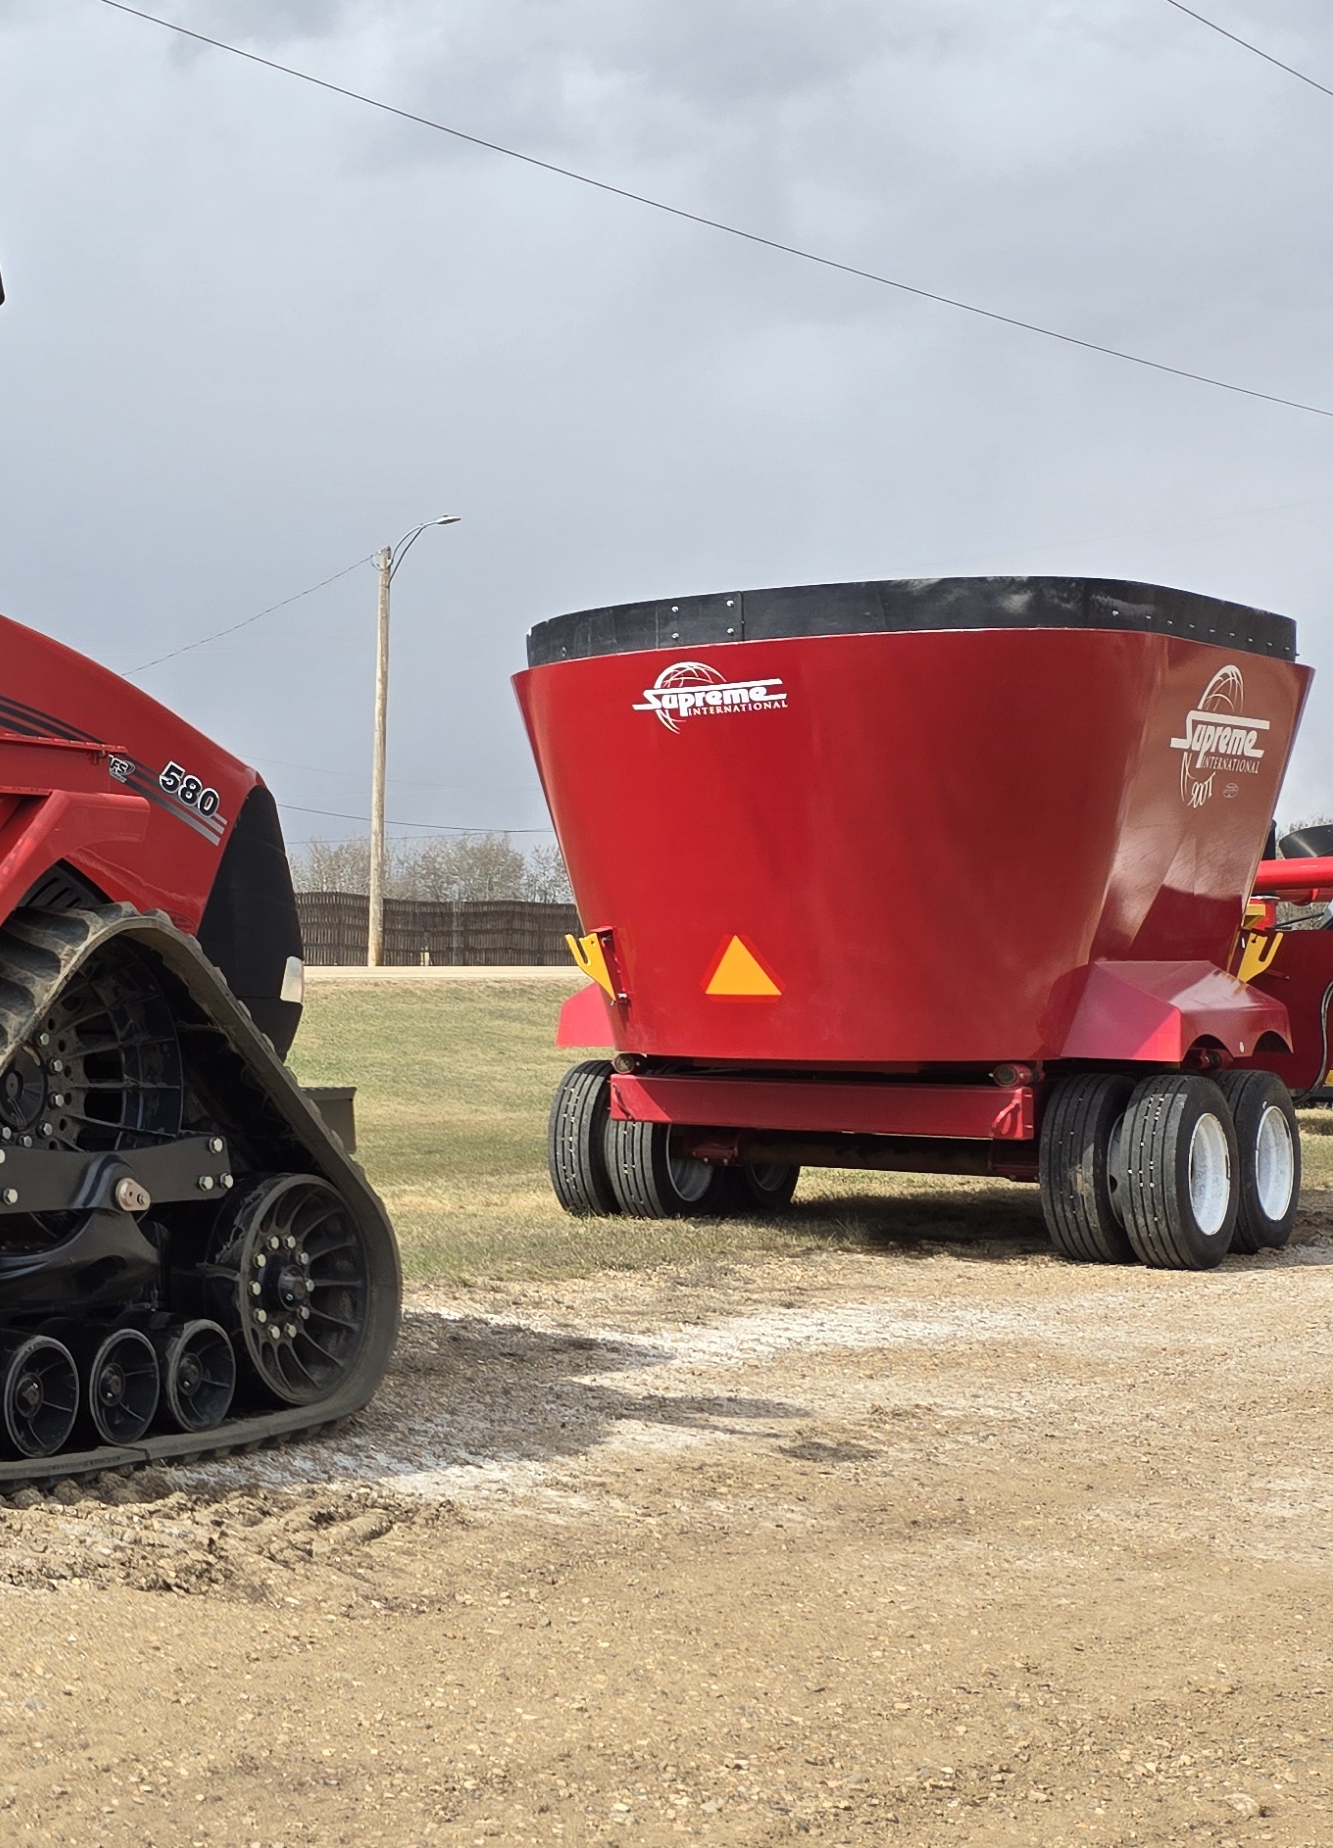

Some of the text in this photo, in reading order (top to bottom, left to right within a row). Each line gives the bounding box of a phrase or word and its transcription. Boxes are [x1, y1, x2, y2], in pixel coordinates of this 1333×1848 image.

[632, 678, 788, 717] Supreme
[688, 700, 788, 716] INTERNATIONAL
[1170, 709, 1271, 769] Supreme
[1200, 755, 1261, 774] INTERNATIONAL
[159, 760, 220, 818] 580
